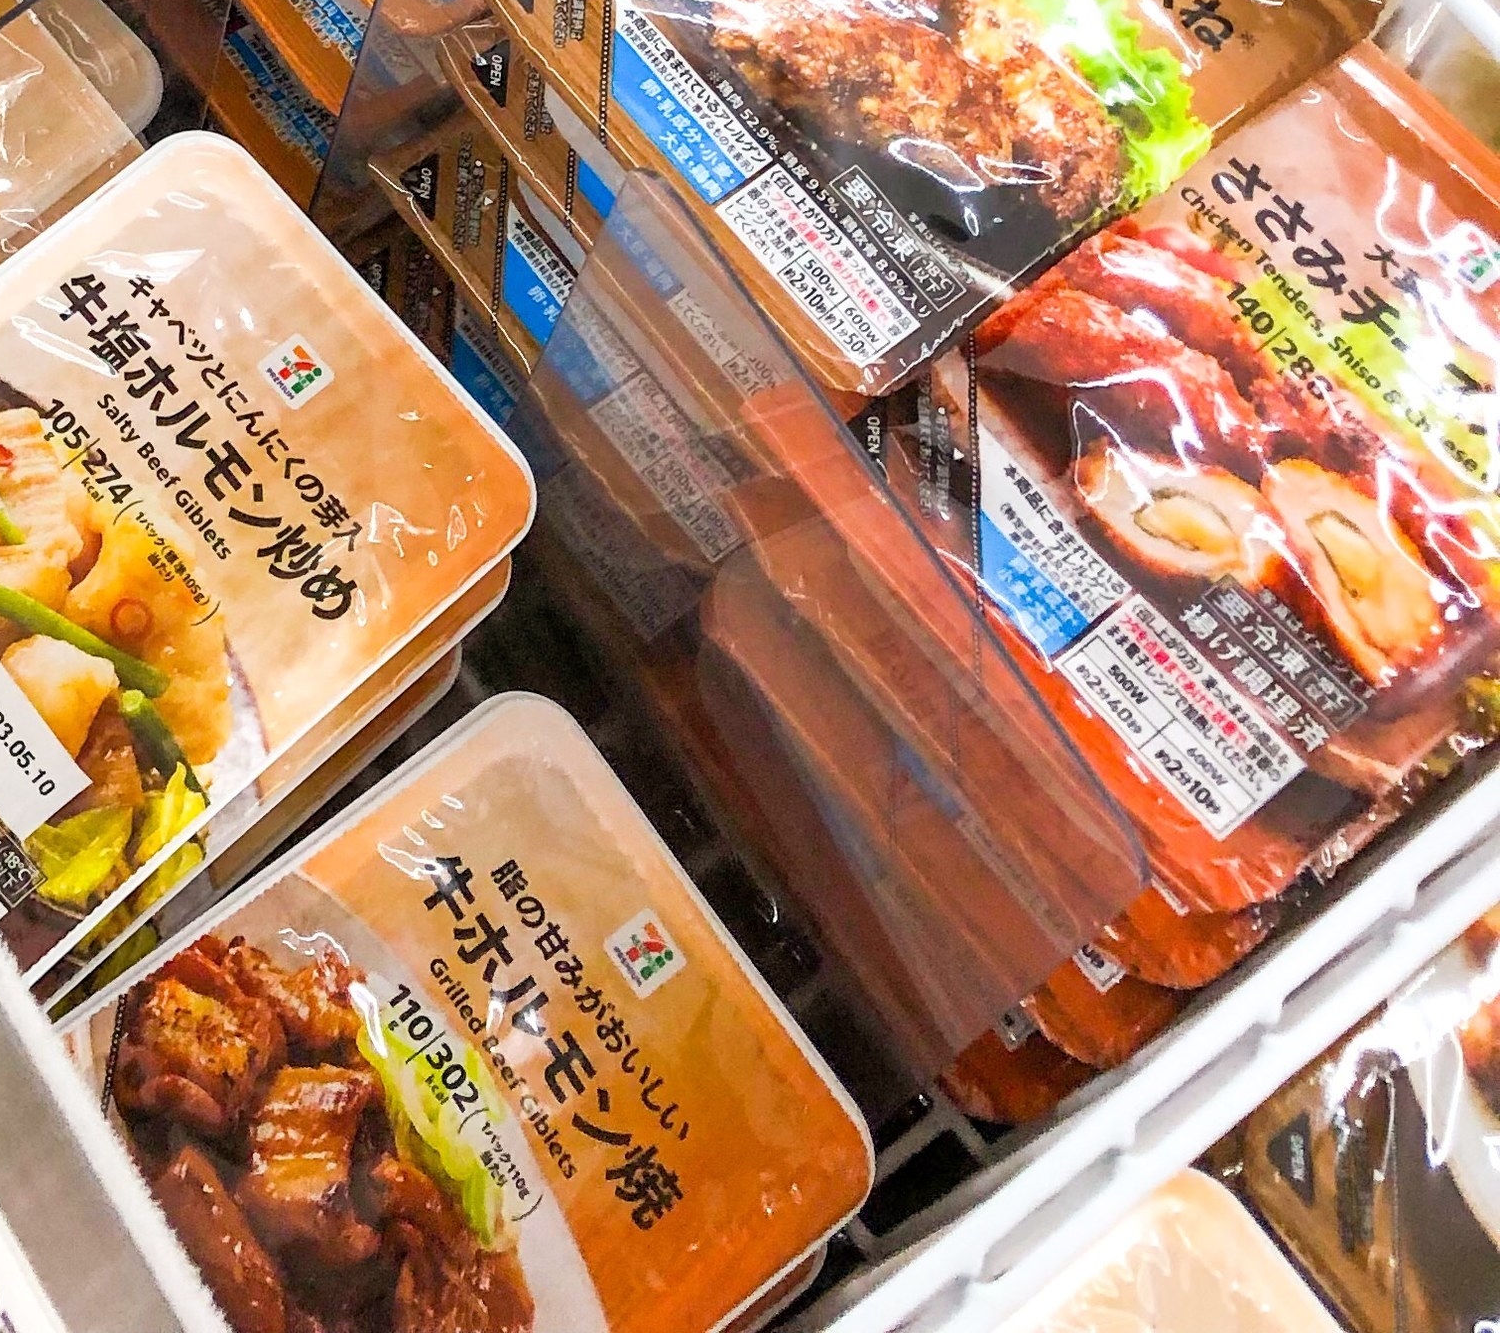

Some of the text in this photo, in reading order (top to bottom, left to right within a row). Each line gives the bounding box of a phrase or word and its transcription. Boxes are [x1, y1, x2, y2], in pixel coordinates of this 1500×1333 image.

[487, 49, 504, 90] OPEN
[839, 175, 917, 259] 要冷凍
[803, 253, 882, 347] 500W 600W
[1178, 185, 1247, 253] Chicken
[1329, 336, 1375, 391] Shiso
[1224, 282, 1276, 339] 140
[57, 270, 353, 623] 牛塩ホルモン炒め
[263, 363, 298, 406] PREMIUM
[865, 415, 882, 456] OPEN
[42, 397, 133, 508] 105 274
[95, 390, 233, 562] Salty Beef Giblets
[1107, 664, 1228, 787] 500W 600W
[1177, 601, 1330, 757] 揚げ調理済
[387, 984, 483, 1115] 110 302
[421, 852, 687, 1232] 牛ホルモン焼
[489, 857, 694, 1146] 脂の甘みがおいしい
[427, 956, 579, 1183] Grilled Giblets
